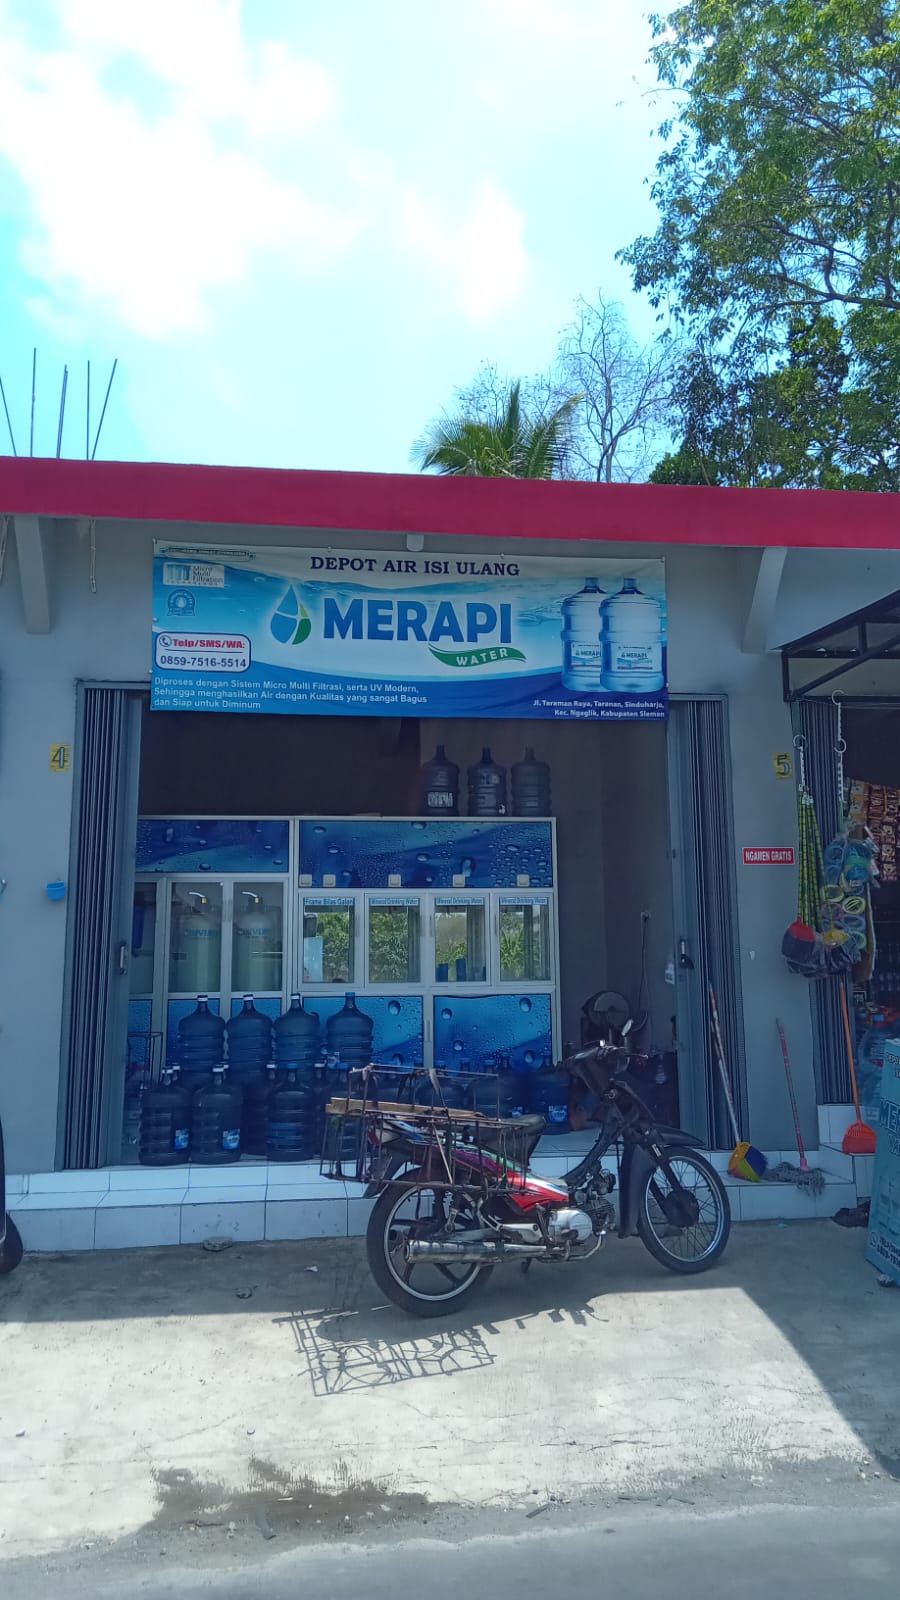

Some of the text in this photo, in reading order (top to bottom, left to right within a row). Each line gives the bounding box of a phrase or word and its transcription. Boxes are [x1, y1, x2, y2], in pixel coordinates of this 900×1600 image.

[311, 556, 520, 577] DEPOT AIR ISI ULANG
[323, 599, 512, 644] MERAPI
[173, 638, 245, 650] Telp/SMS/WA:
[160, 655, 247, 668] 0859-7516-5514
[456, 647, 509, 666] WATER
[154, 676, 419, 694] Diproses dengan Sistem Micro Multi Filtrasi, serta UV Modern,
[154, 687, 428, 705] Sehingga menghasilkan Air dengan Kualitas yang sangat Bagus
[154, 698, 261, 709] dan Siap untuk Diminum
[573, 700, 592, 709] Raya,
[554, 709, 568, 717] Kec.
[600, 710, 638, 718] Kabupaten
[639, 710, 665, 718] Sleman
[51, 746, 69, 769] 4
[776, 753, 791, 776] 5
[745, 850, 792, 862] NGAMEN GRATIS
